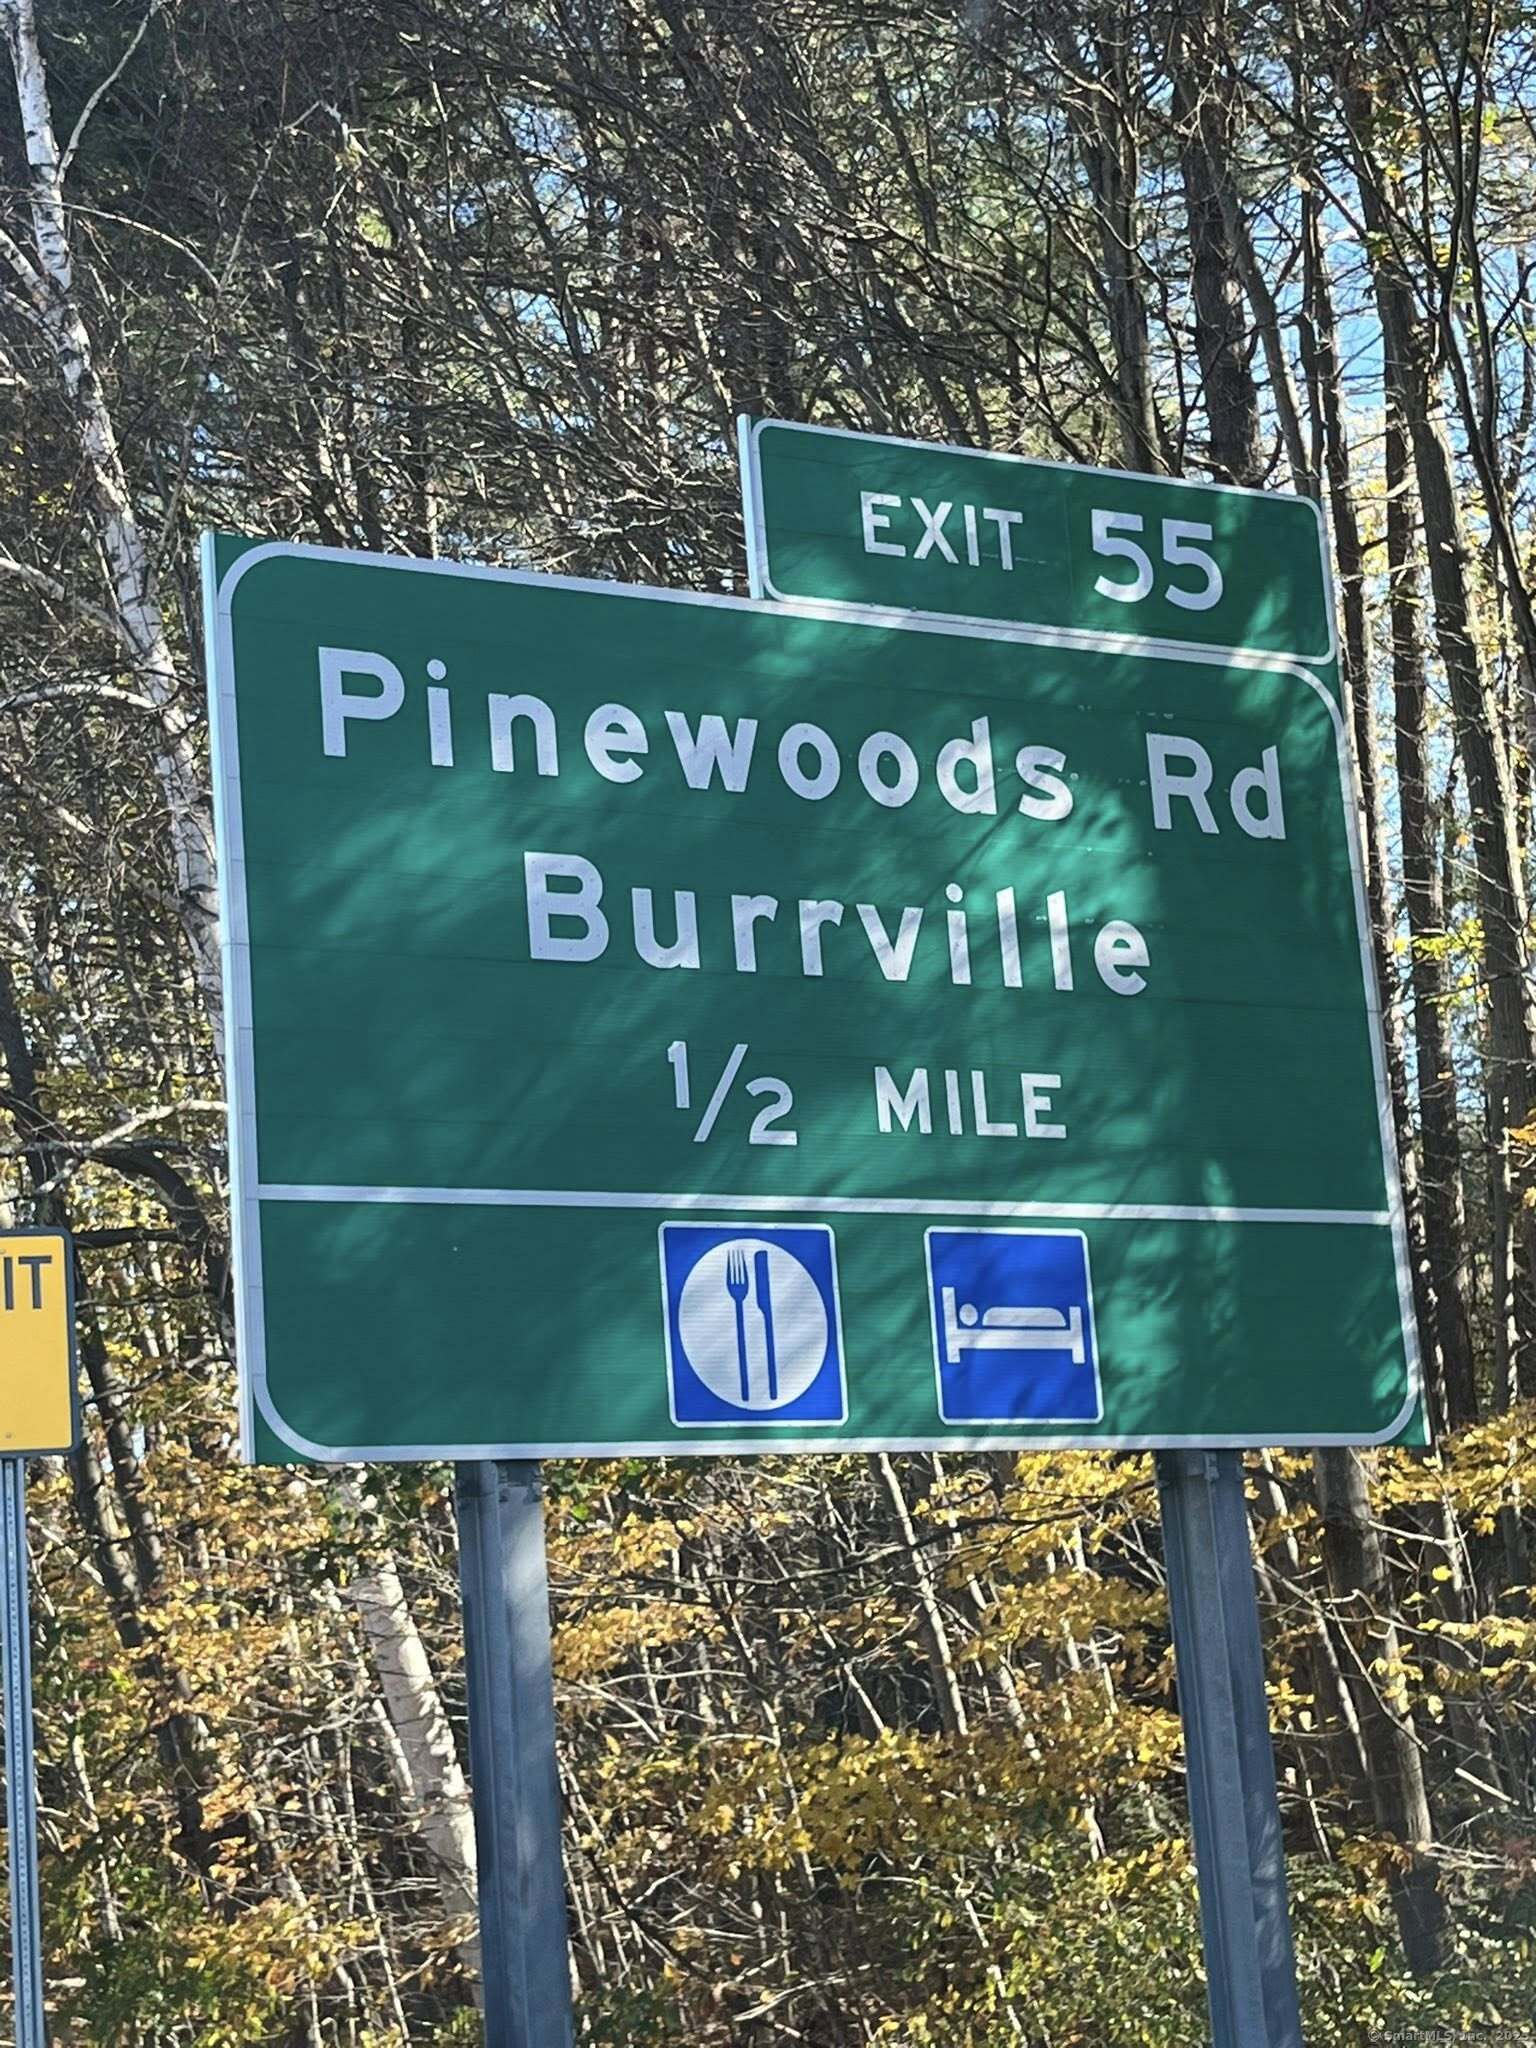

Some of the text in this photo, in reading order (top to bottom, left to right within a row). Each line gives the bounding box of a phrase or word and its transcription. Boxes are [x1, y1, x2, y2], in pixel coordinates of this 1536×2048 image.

[860, 490, 1223, 611] EXIT 55
[318, 646, 1287, 841] Pinewoods Rd
[524, 851, 1151, 996] Burrville
[667, 1040, 1067, 1146] 1/2 MILE
